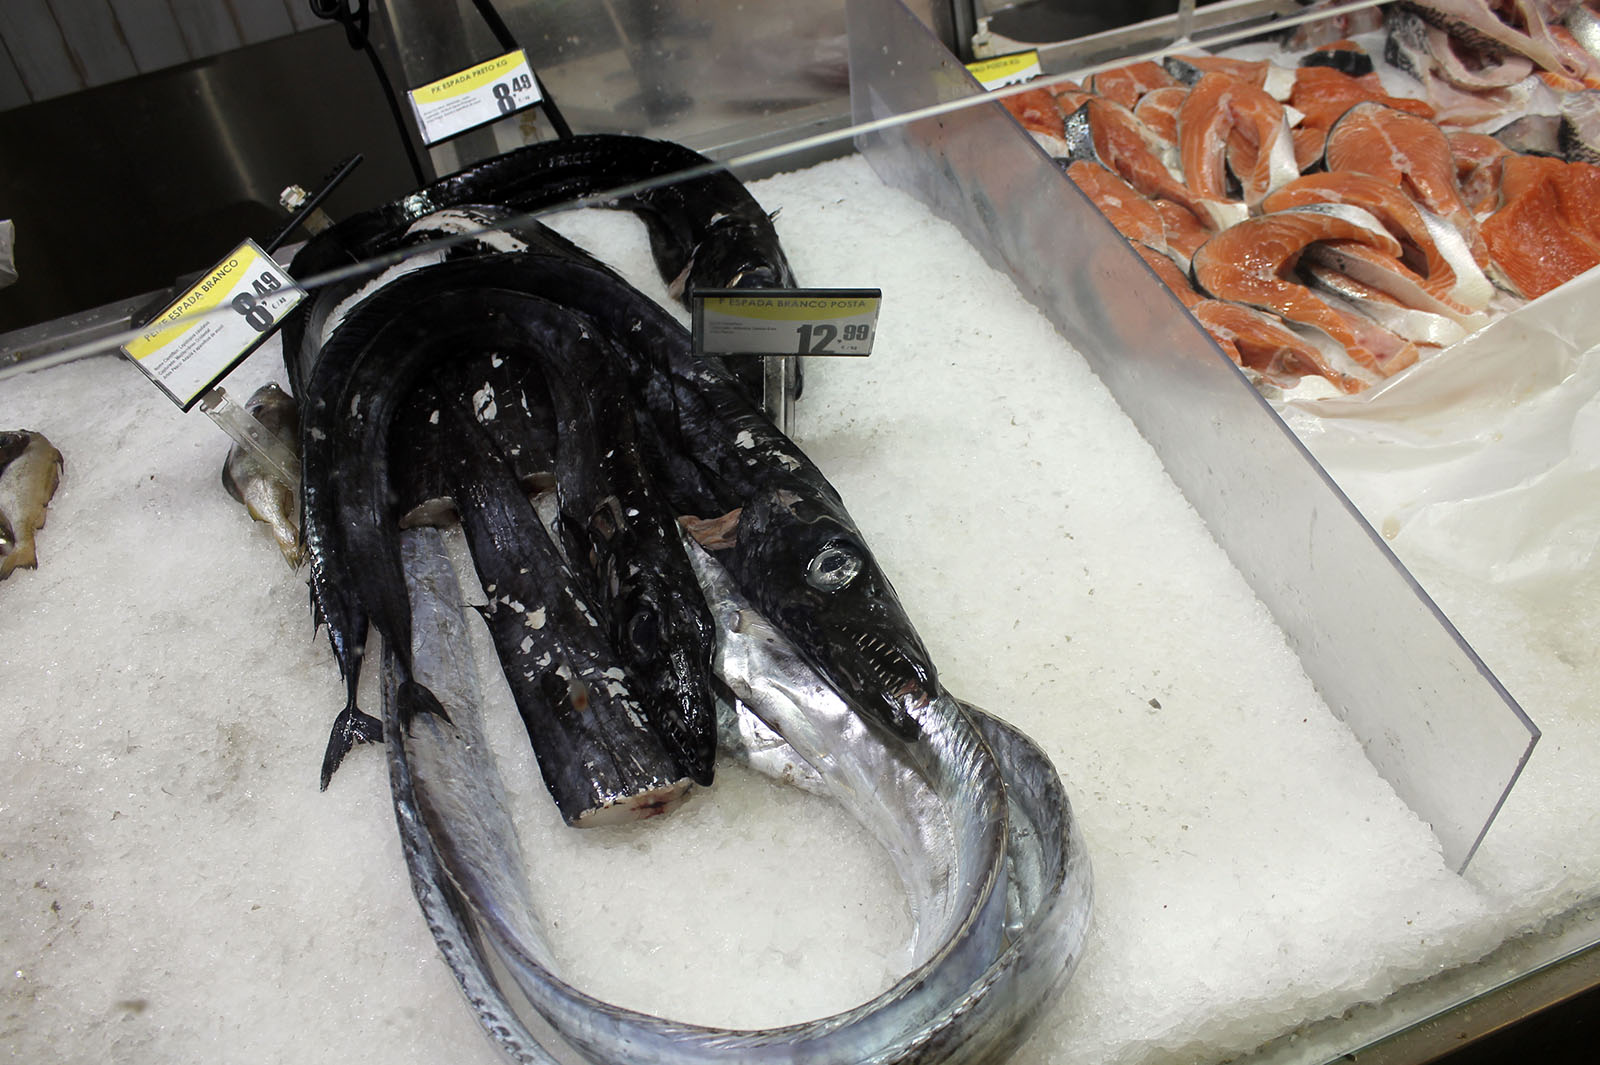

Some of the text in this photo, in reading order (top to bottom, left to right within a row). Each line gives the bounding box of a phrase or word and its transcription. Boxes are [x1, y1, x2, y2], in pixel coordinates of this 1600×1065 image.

[431, 60, 508, 95] PX ESPADA PRETO KG
[168, 290, 203, 321] ESPADA
[202, 259, 239, 293] BRANCO
[729, 299, 774, 308] ESPADA
[777, 300, 828, 309] BRANCO
[831, 300, 867, 310] POSTA
